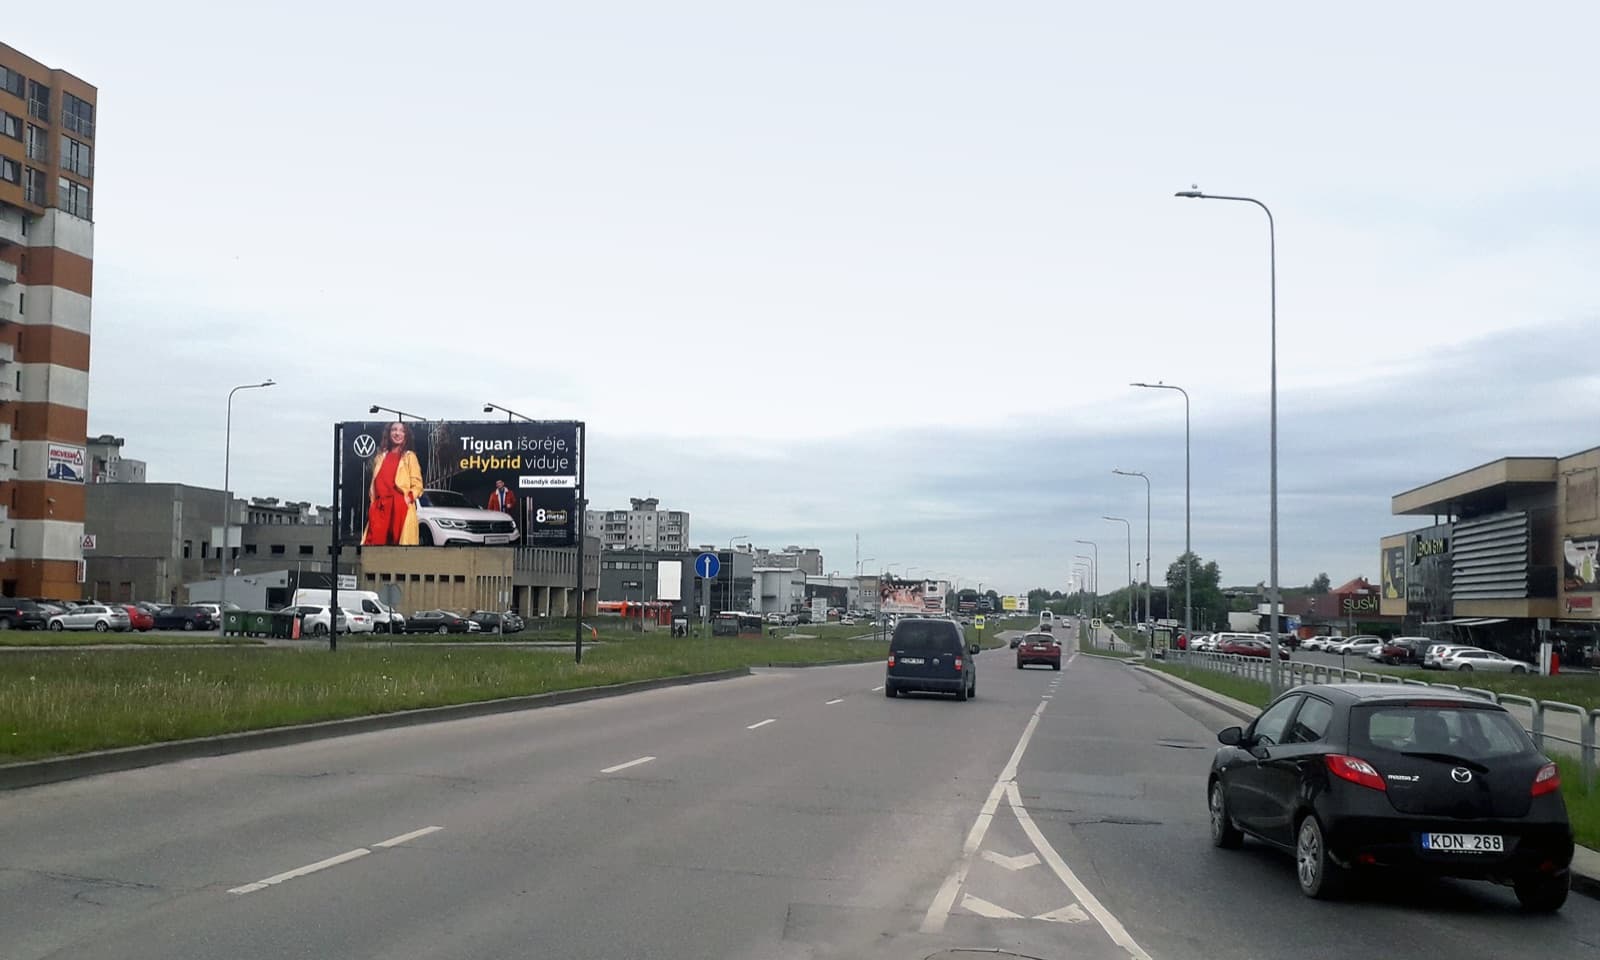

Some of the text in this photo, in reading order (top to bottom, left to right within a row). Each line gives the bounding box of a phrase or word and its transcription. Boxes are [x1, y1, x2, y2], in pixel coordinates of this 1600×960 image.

[460, 436, 569, 454] Tiguan išorėje,
[460, 455, 569, 472] eHybrid viduje
[536, 508, 546, 523] 8
[1430, 834, 1464, 849] KDN
[1473, 836, 1501, 850] 268
